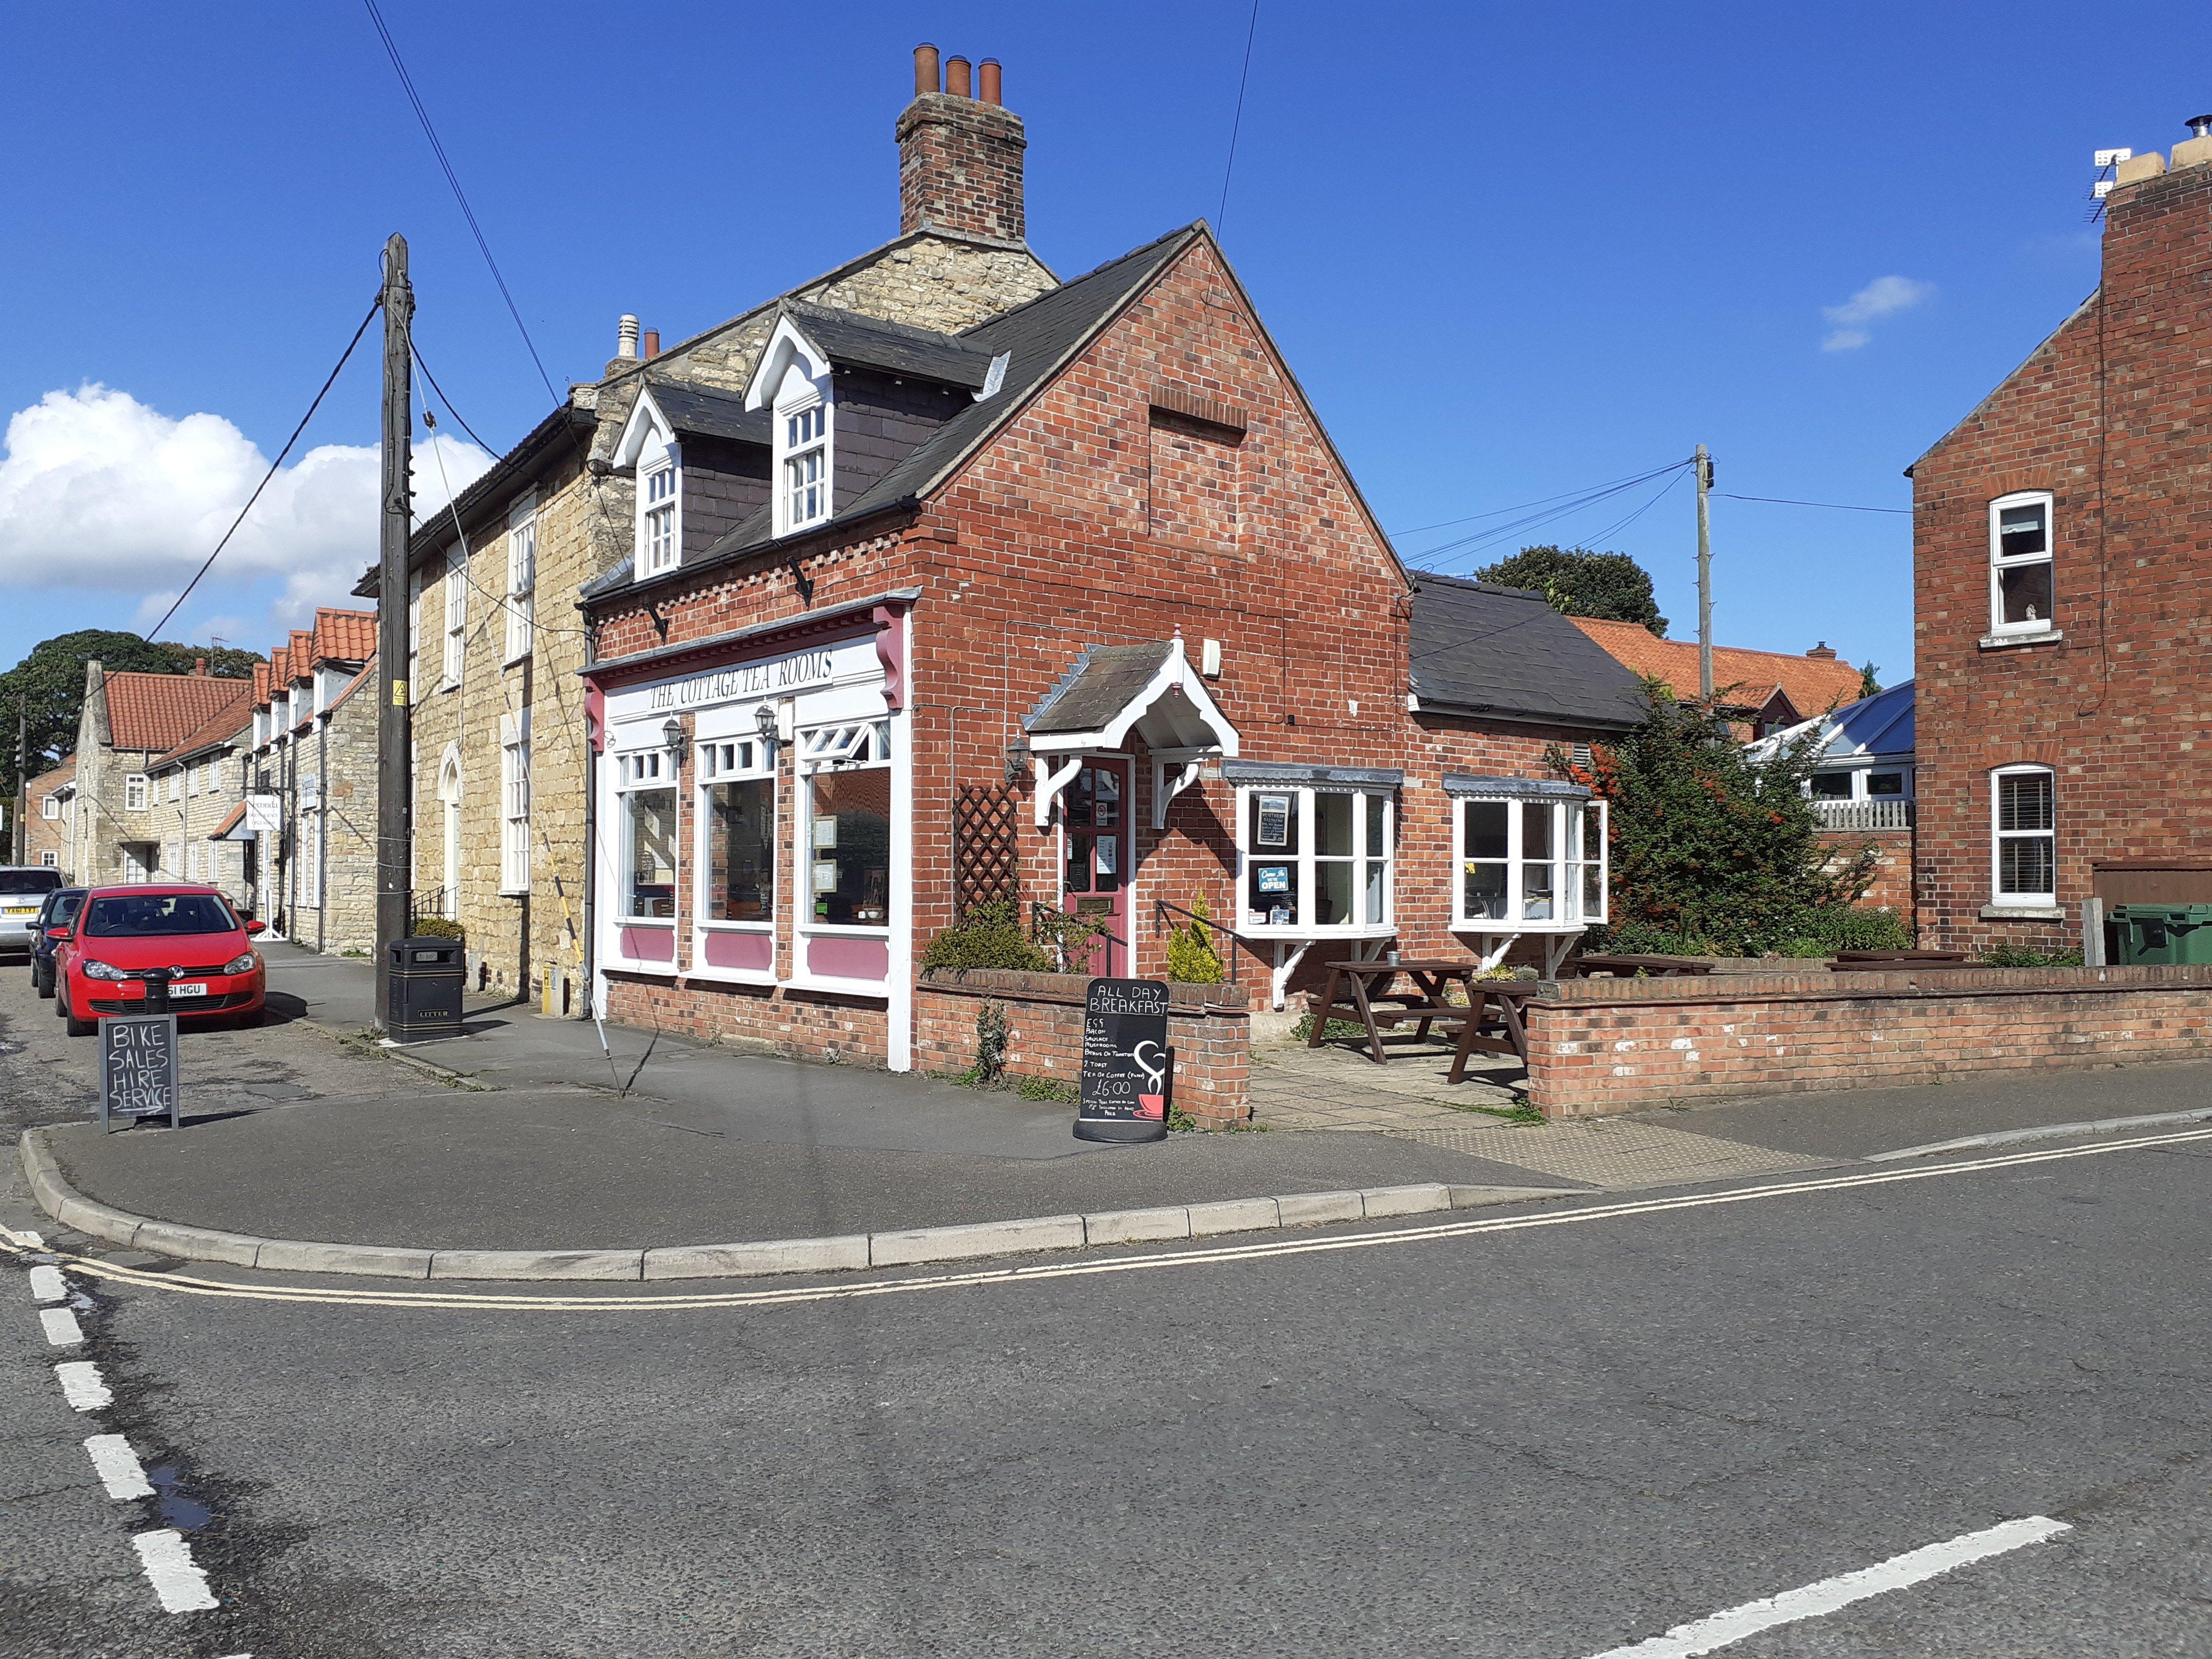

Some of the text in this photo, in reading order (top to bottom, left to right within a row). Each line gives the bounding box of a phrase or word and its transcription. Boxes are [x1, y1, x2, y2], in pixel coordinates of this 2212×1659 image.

[651, 649, 832, 708] THE COTTAGE TEA ROOMS
[1261, 869, 1285, 879] Come In
[1261, 881, 1286, 890] OPEN
[180, 984, 200, 995] HGU
[1097, 985, 1162, 1001] ALL DAY
[1090, 998, 1168, 1014] BREAKFAST
[113, 1025, 165, 1048] BIKE
[108, 1048, 168, 1071] SALES
[114, 1070, 165, 1090] HIRE
[109, 1087, 171, 1109] SERVICE
